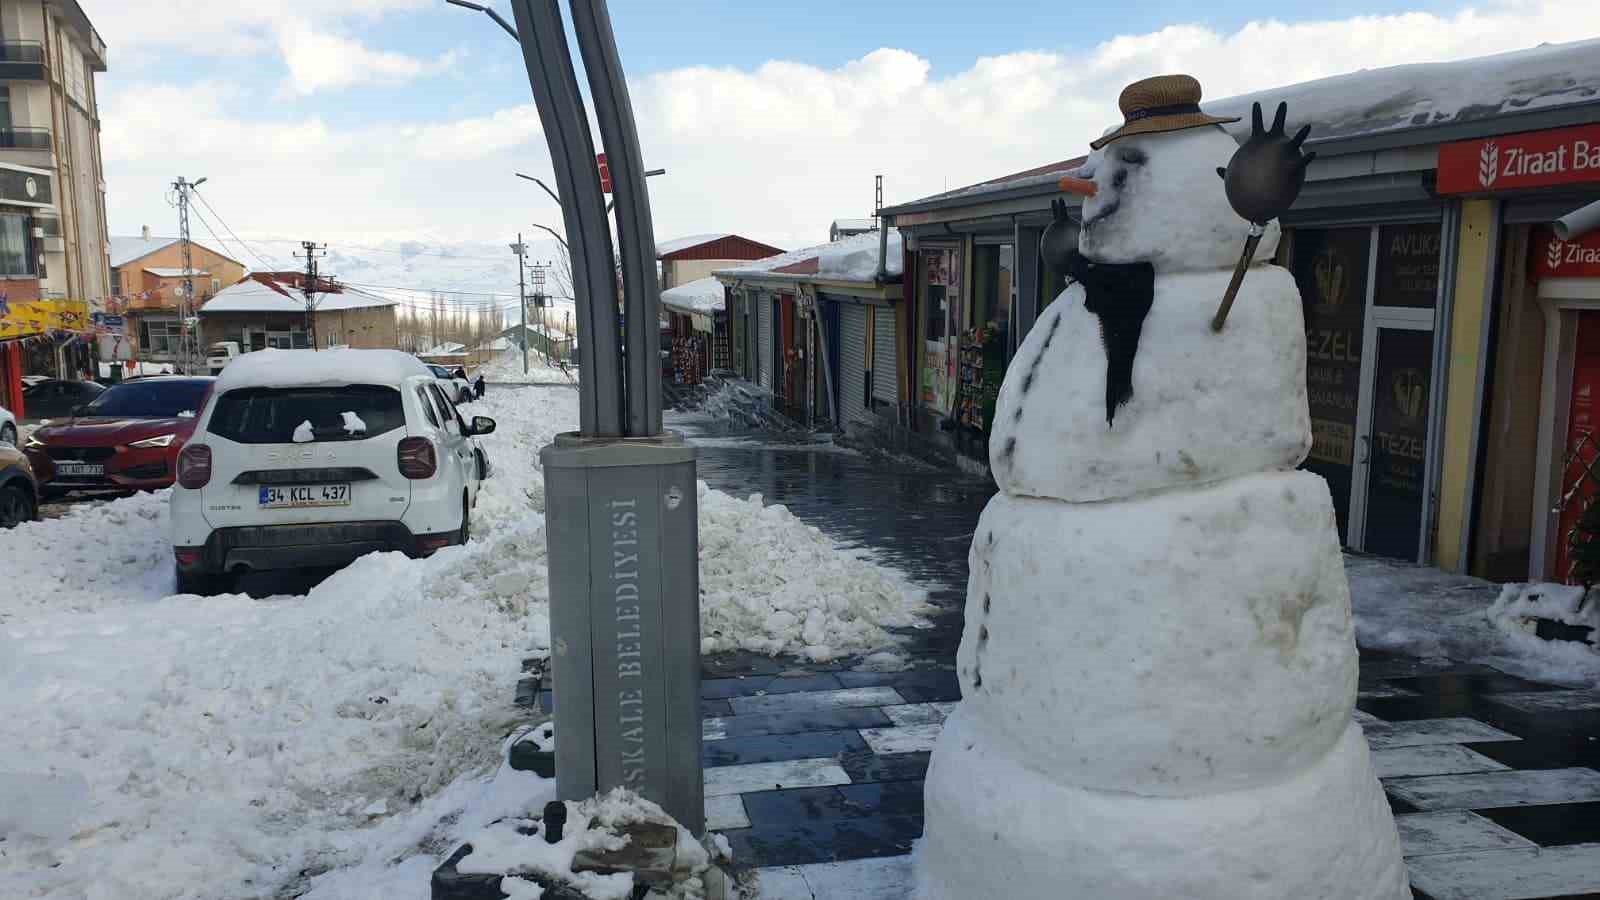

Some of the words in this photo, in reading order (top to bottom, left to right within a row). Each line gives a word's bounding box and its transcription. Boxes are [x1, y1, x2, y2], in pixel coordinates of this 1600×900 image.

[1502, 145, 1567, 177] Ziraat
[269, 488, 284, 502] 34
[290, 487, 315, 501] KCL
[322, 486, 346, 500] 437
[605, 496, 643, 679] BELEDİYESİ
